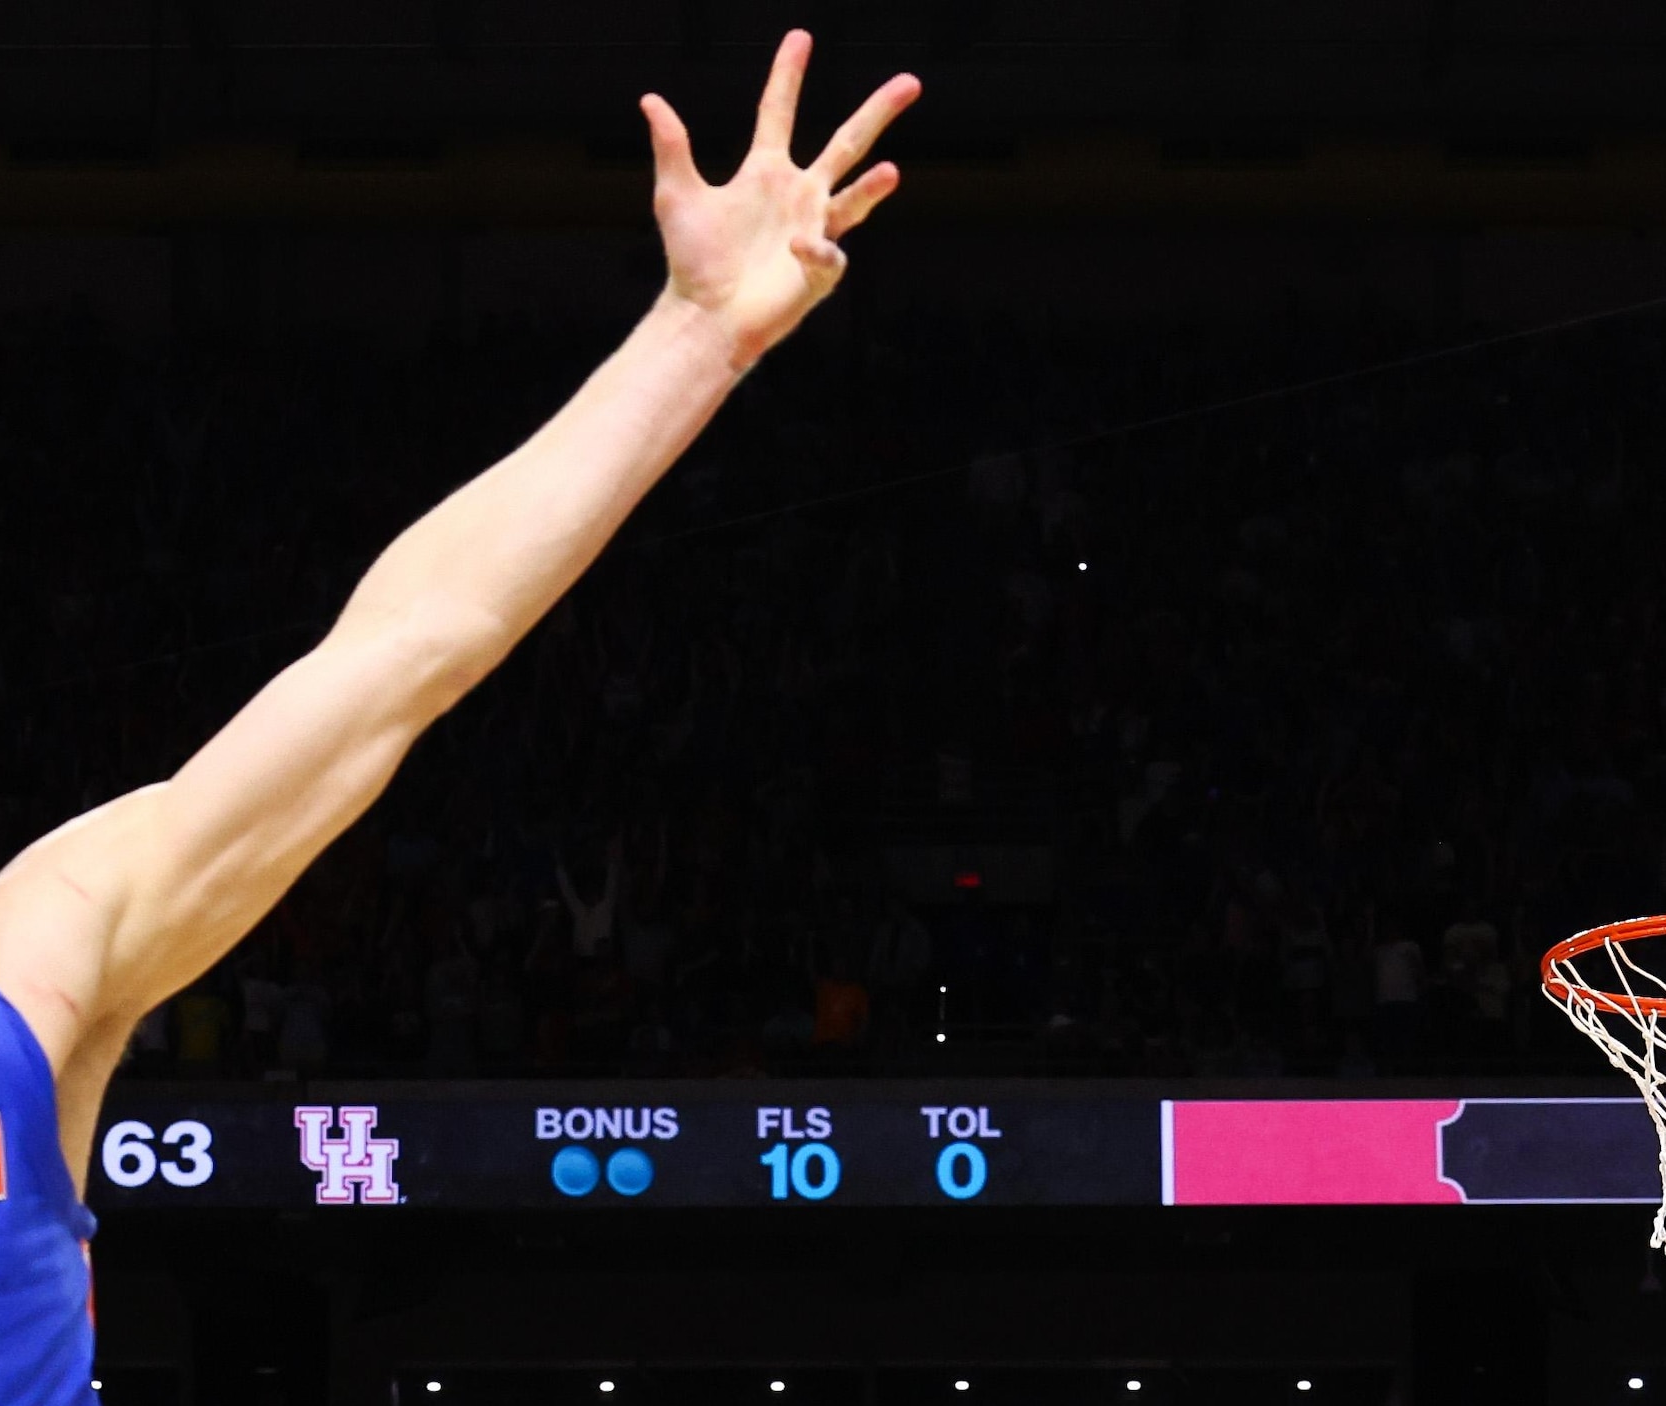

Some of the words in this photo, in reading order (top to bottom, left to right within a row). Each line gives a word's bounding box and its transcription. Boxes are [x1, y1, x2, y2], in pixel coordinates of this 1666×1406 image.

[535, 1106, 680, 1140] BONUS
[756, 1106, 833, 1140] FLS
[920, 1106, 1002, 1139] TOL
[101, 1119, 214, 1188] 63
[759, 1142, 842, 1200] 10
[935, 1142, 988, 1200] 0
